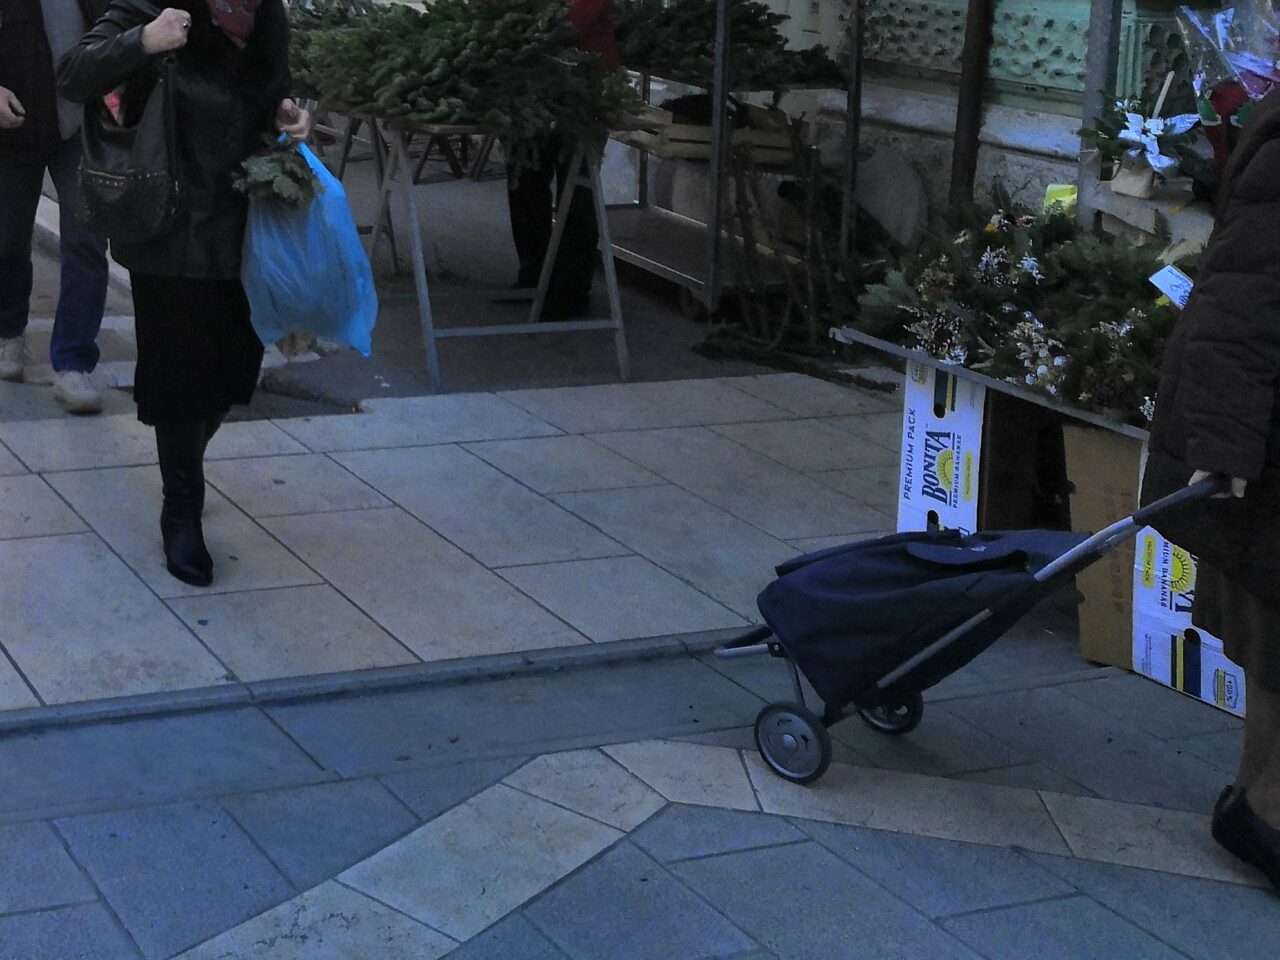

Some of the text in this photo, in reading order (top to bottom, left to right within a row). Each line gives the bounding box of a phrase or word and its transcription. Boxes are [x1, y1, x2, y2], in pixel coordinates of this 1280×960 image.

[903, 408, 917, 501] PREMIUM PACK
[921, 430, 952, 506] BONITA
[952, 473, 960, 509] PREMIUM
[1160, 567, 1169, 608] BANANAS
